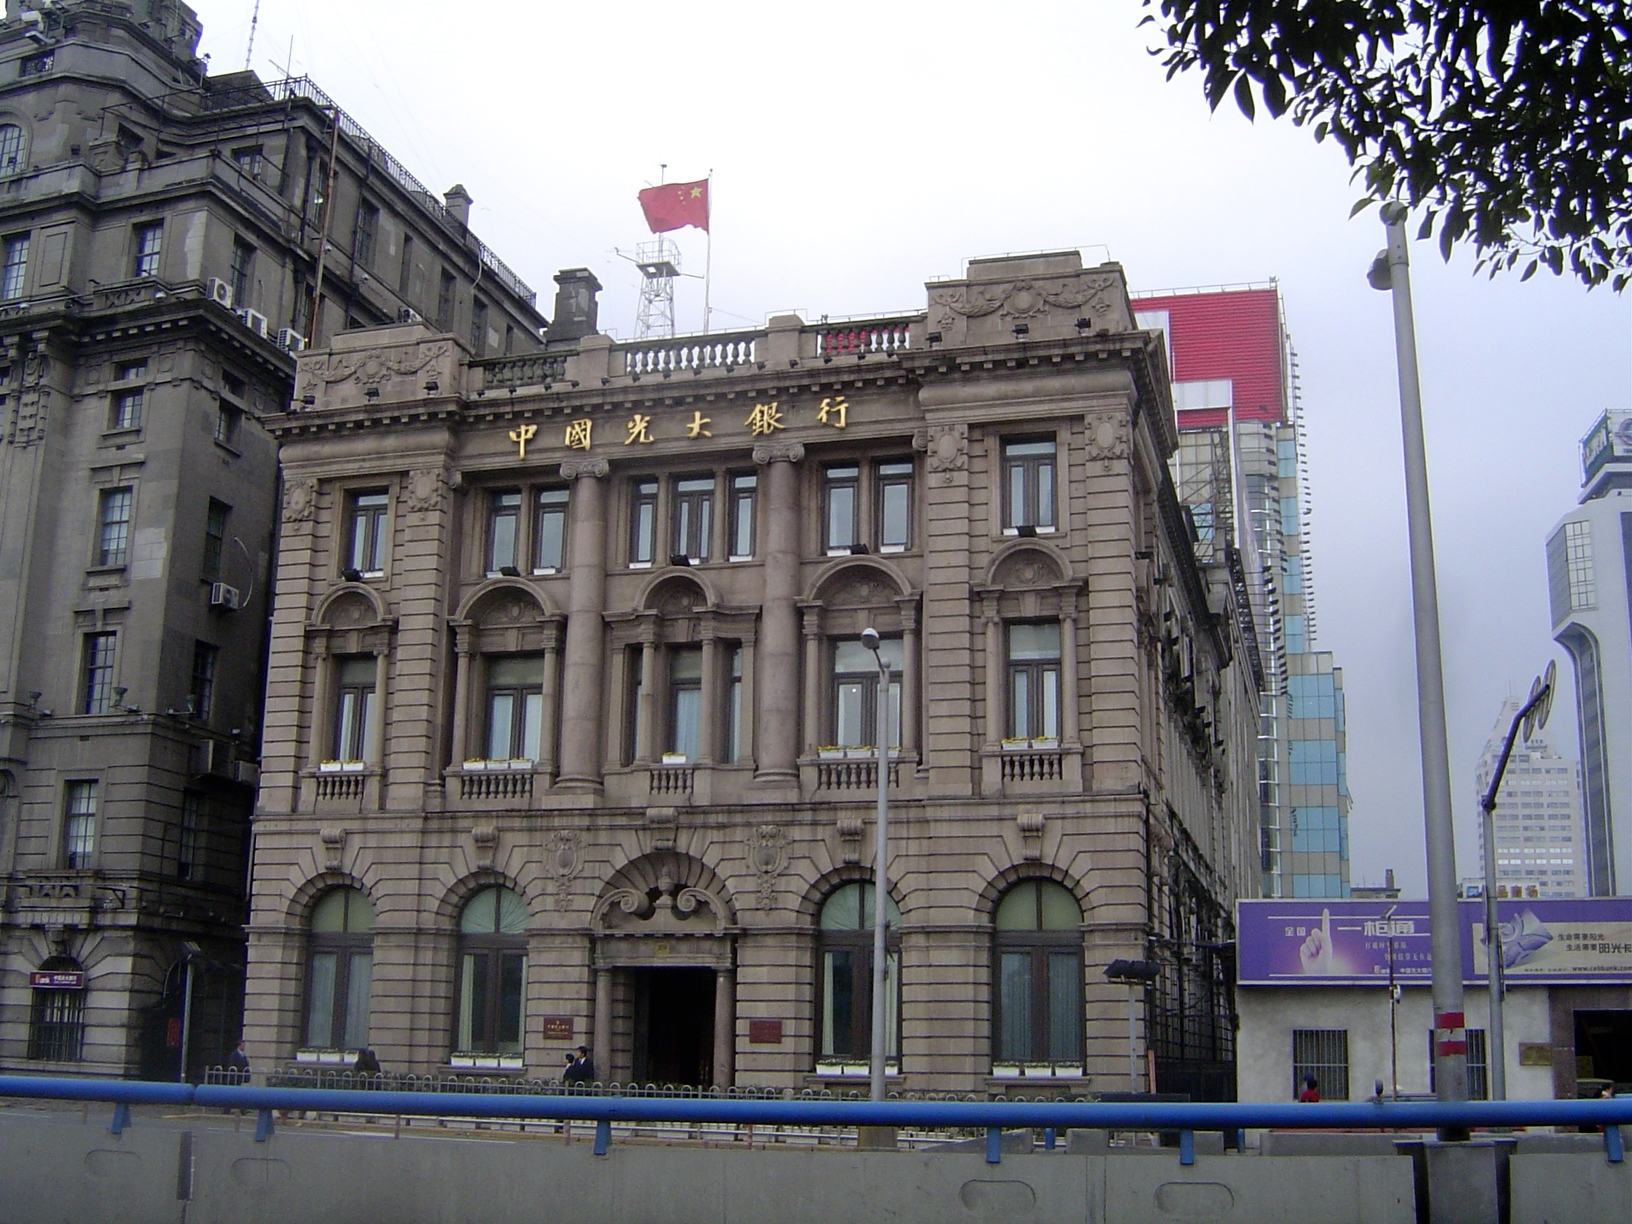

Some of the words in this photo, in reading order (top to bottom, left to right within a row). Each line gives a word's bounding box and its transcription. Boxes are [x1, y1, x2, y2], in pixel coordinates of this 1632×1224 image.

[508, 395, 850, 461] 中國光大銀行
